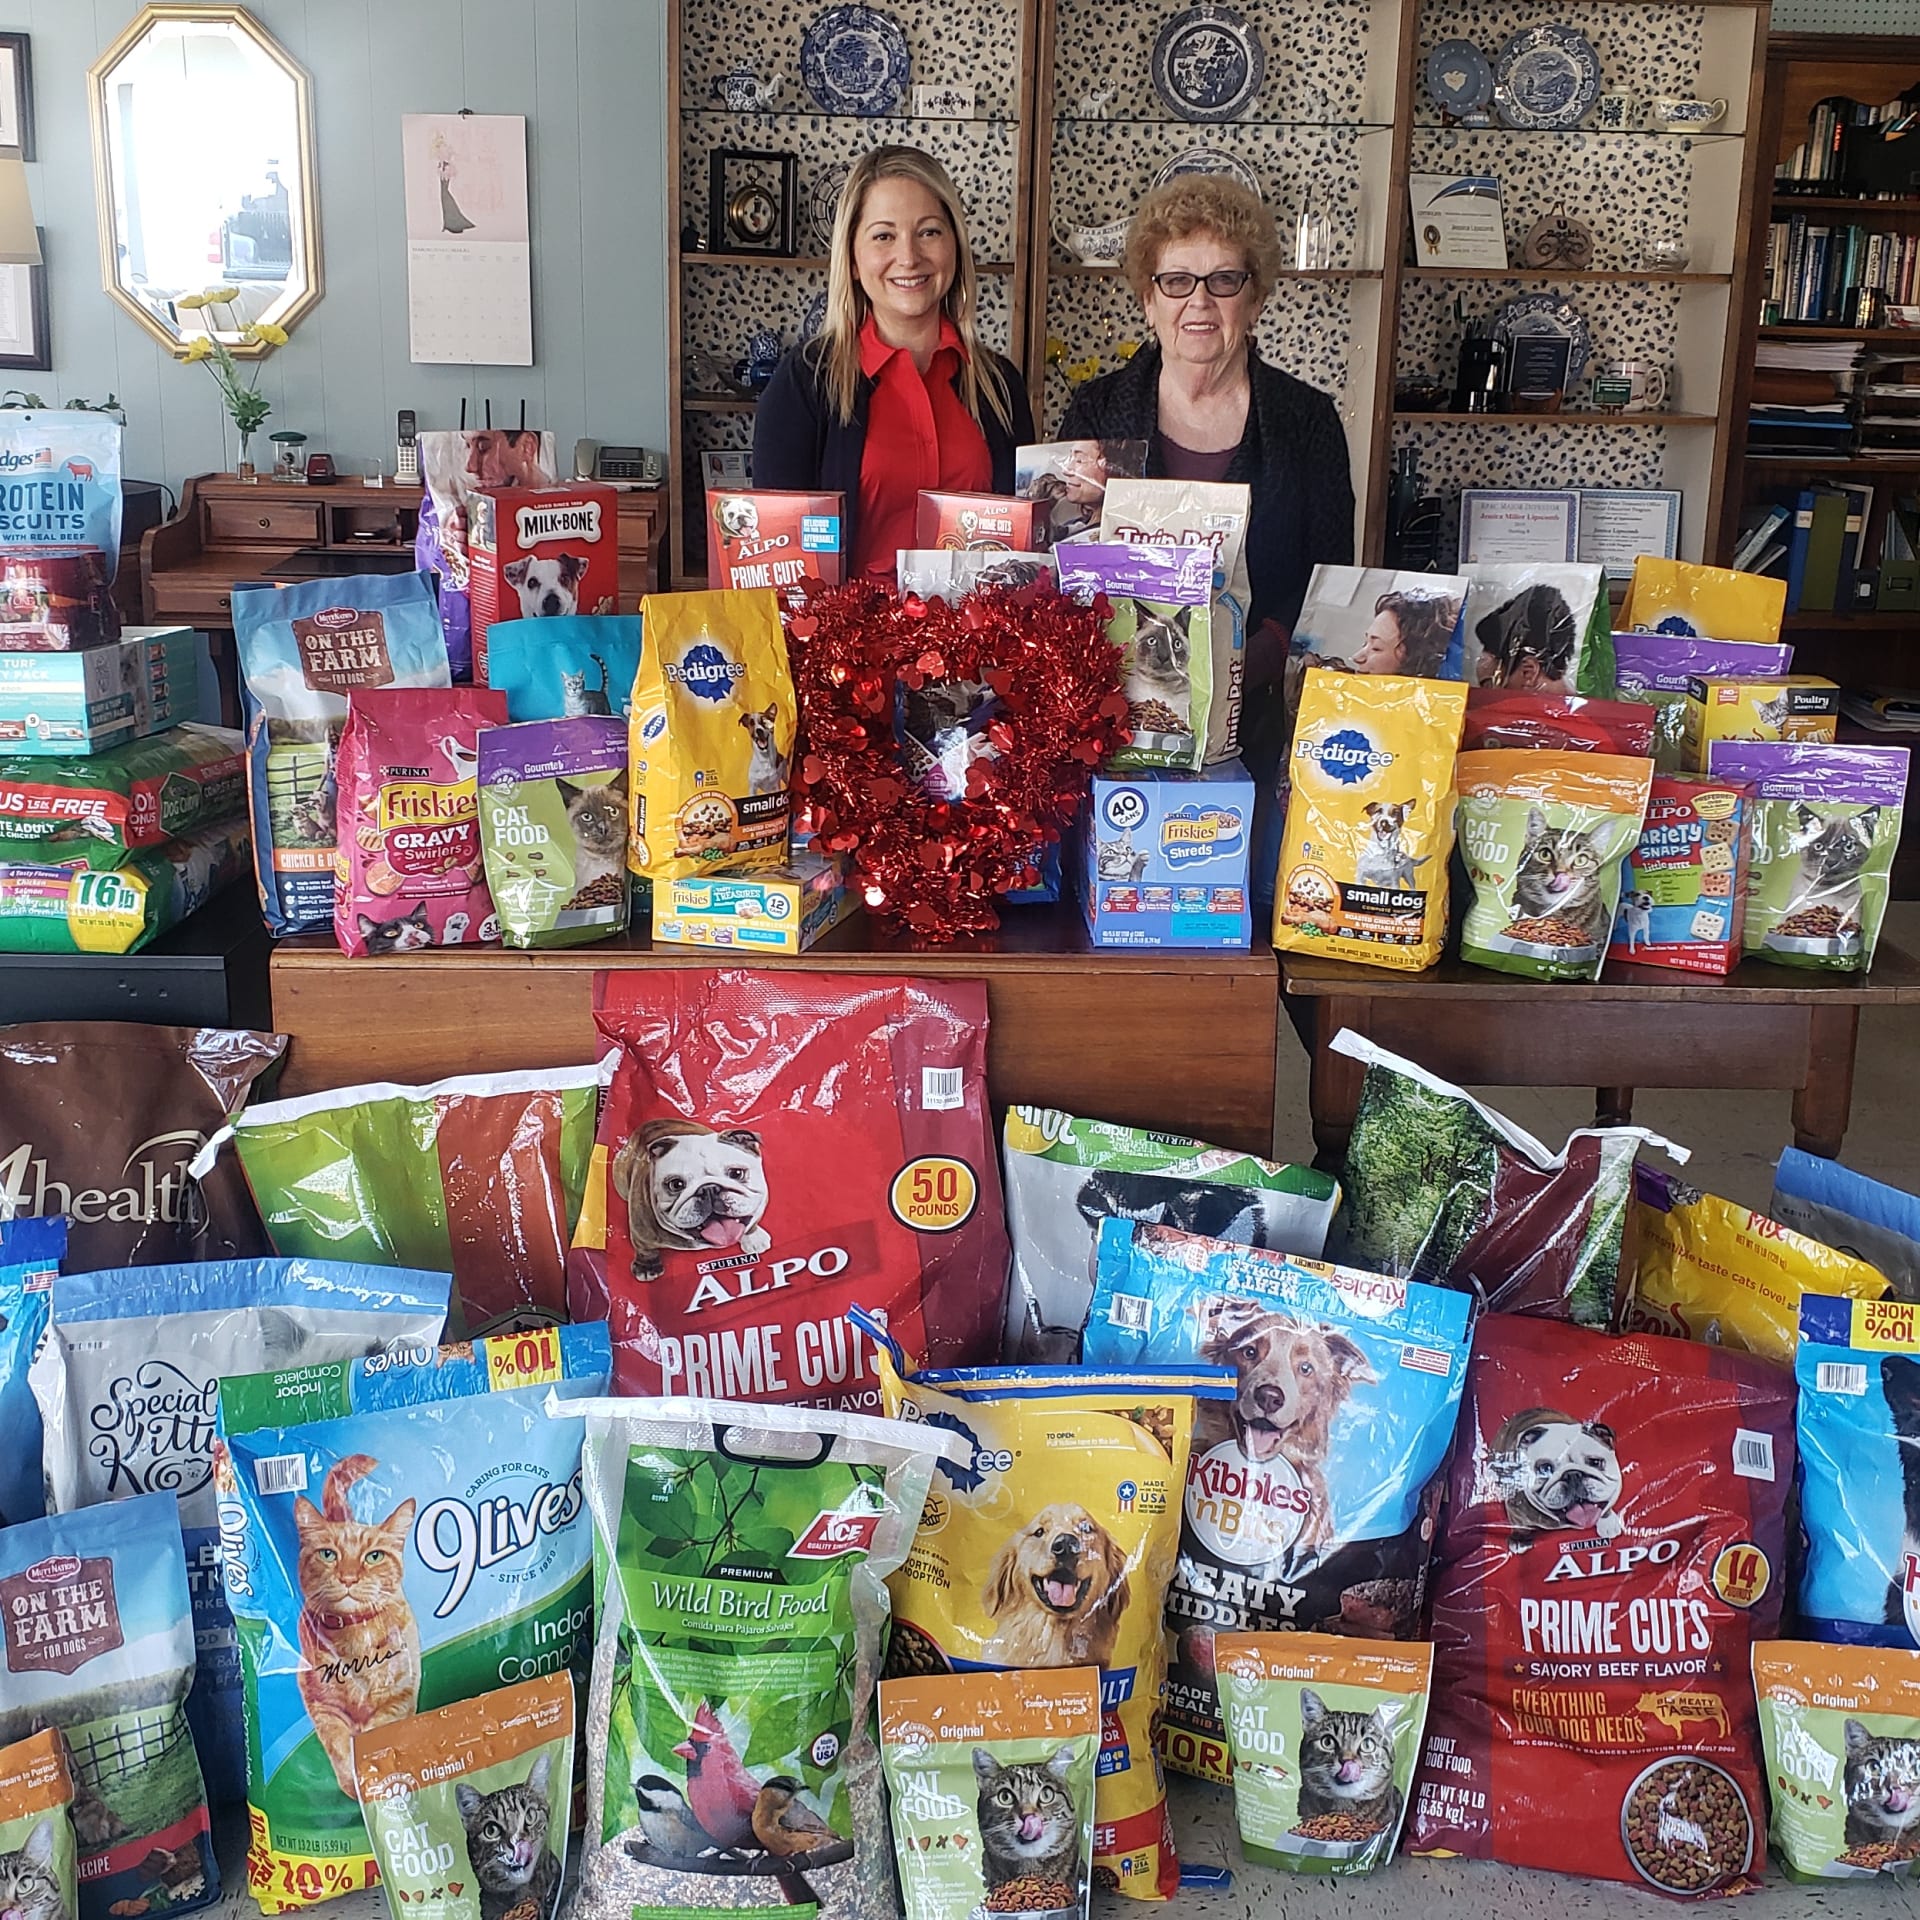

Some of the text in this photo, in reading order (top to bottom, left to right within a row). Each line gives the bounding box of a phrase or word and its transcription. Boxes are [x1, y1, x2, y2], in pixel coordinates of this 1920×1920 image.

[984, 506, 1008, 516] ALPO
[997, 519, 1012, 533] CUTS
[738, 534, 790, 559] ALPO
[730, 560, 806, 590] PRIME CUTS
[1105, 579, 1136, 590] Gourmet
[305, 628, 378, 651] ON THE
[4, 659, 37, 668] TURF
[308, 646, 382, 672] FARM
[664, 661, 744, 683] Pedigree
[1229, 659, 1243, 692] Pet
[1793, 695, 1830, 706] Poultry
[1296, 740, 1394, 768] Pedigree
[389, 767, 429, 777] PURINA
[52, 798, 108, 817] FREE
[386, 790, 478, 821] Friskies
[743, 796, 776, 814] small
[1112, 796, 1138, 818] 40
[15, 821, 55, 834] ADULT
[492, 806, 529, 828] CAT
[1120, 810, 1140, 824] CANS
[393, 825, 470, 849] GRAVY
[494, 824, 550, 848] FOOD
[1167, 824, 1215, 840] Friskies
[1466, 818, 1502, 840] CAT
[280, 854, 316, 868] CHICKEN
[404, 844, 462, 861] Swirlers
[1170, 844, 1212, 859] Shreds
[1640, 845, 1691, 859] SNAPS
[16, 870, 32, 878] Tasty
[80, 874, 122, 908] 16
[673, 891, 708, 905] Friskies
[1346, 890, 1424, 909] small dog
[770, 898, 784, 909] 12
[1090, 1122, 1134, 1142] Indoor
[1146, 1132, 1193, 1148] PURINA
[912, 1168, 958, 1202] 50
[908, 1202, 959, 1218] POUNDS
[710, 1253, 759, 1270] PURINA
[1290, 1257, 1326, 1272] CRUNCHY
[683, 1246, 850, 1315] ALPO
[1332, 1274, 1406, 1308] Kibbles
[1698, 1257, 1786, 1306] taste cats love!
[1866, 1302, 1914, 1321] MORE
[1864, 1319, 1914, 1343] 10%
[493, 1338, 557, 1377] 10%
[661, 1326, 787, 1398] PRIME
[274, 1364, 341, 1386] Complete
[90, 1360, 218, 1437] Special
[276, 1382, 322, 1400] Indoor
[466, 1462, 550, 1499] CARING FOR CATS
[1190, 1450, 1311, 1516] Kibbles
[1140, 1493, 1166, 1504] USA
[818, 1521, 864, 1542] ACE
[806, 1542, 832, 1550] QUALITY
[1570, 1538, 1611, 1552] PURINA
[1544, 1539, 1681, 1583] ALPO
[1728, 1549, 1758, 1586] 14
[498, 1570, 538, 1584] SINCE
[720, 1567, 774, 1580] PREMIUM
[11, 1578, 106, 1616] ON THE
[652, 1582, 829, 1619] Wild Bird Food
[1724, 1582, 1753, 1602] POUNDS
[14, 1608, 110, 1648] FARM
[681, 1618, 795, 1637] Comida para Pájaros Salvajes
[1520, 1598, 1711, 1654] PRIME CUTS
[43, 1638, 88, 1661] FOR DOGS
[316, 1648, 401, 1684] Morris
[1270, 1664, 1314, 1680] Original
[1530, 1660, 1706, 1679] SAVORY BEEF FLAVOR
[1167, 1680, 1212, 1703] MADE
[1512, 1688, 1606, 1716] EVERYTHING
[1678, 1696, 1715, 1706] MEATY
[1812, 1692, 1858, 1709] Original
[1229, 1703, 1268, 1727] CAT
[1657, 1706, 1718, 1717] TASTE
[940, 1724, 984, 1740] Original
[1514, 1712, 1646, 1743] YOUR DOG NEEDS
[816, 1750, 835, 1761] USA
[1427, 1735, 1456, 1757] ADULT
[1531, 1740, 1574, 1750] COMPLETE
[1583, 1748, 1628, 1756] BALANCED
[1676, 1744, 1692, 1752] FOR
[1695, 1744, 1716, 1753] ADULT
[420, 1756, 466, 1782] Original
[1425, 1752, 1472, 1775] DOG FOOD
[22, 1772, 30, 1780] to
[900, 1770, 941, 1796] CAT
[1420, 1782, 1486, 1810] NET WT 14 LB
[902, 1794, 963, 1821] FOOD
[1416, 1800, 1464, 1825] (6.35 kg)
[276, 1834, 320, 1852] NET WT LB
[384, 1822, 430, 1854] CAT
[390, 1842, 456, 1878] FOOD
[1134, 1860, 1149, 1870] USA
[278, 1860, 354, 1901] 10%
